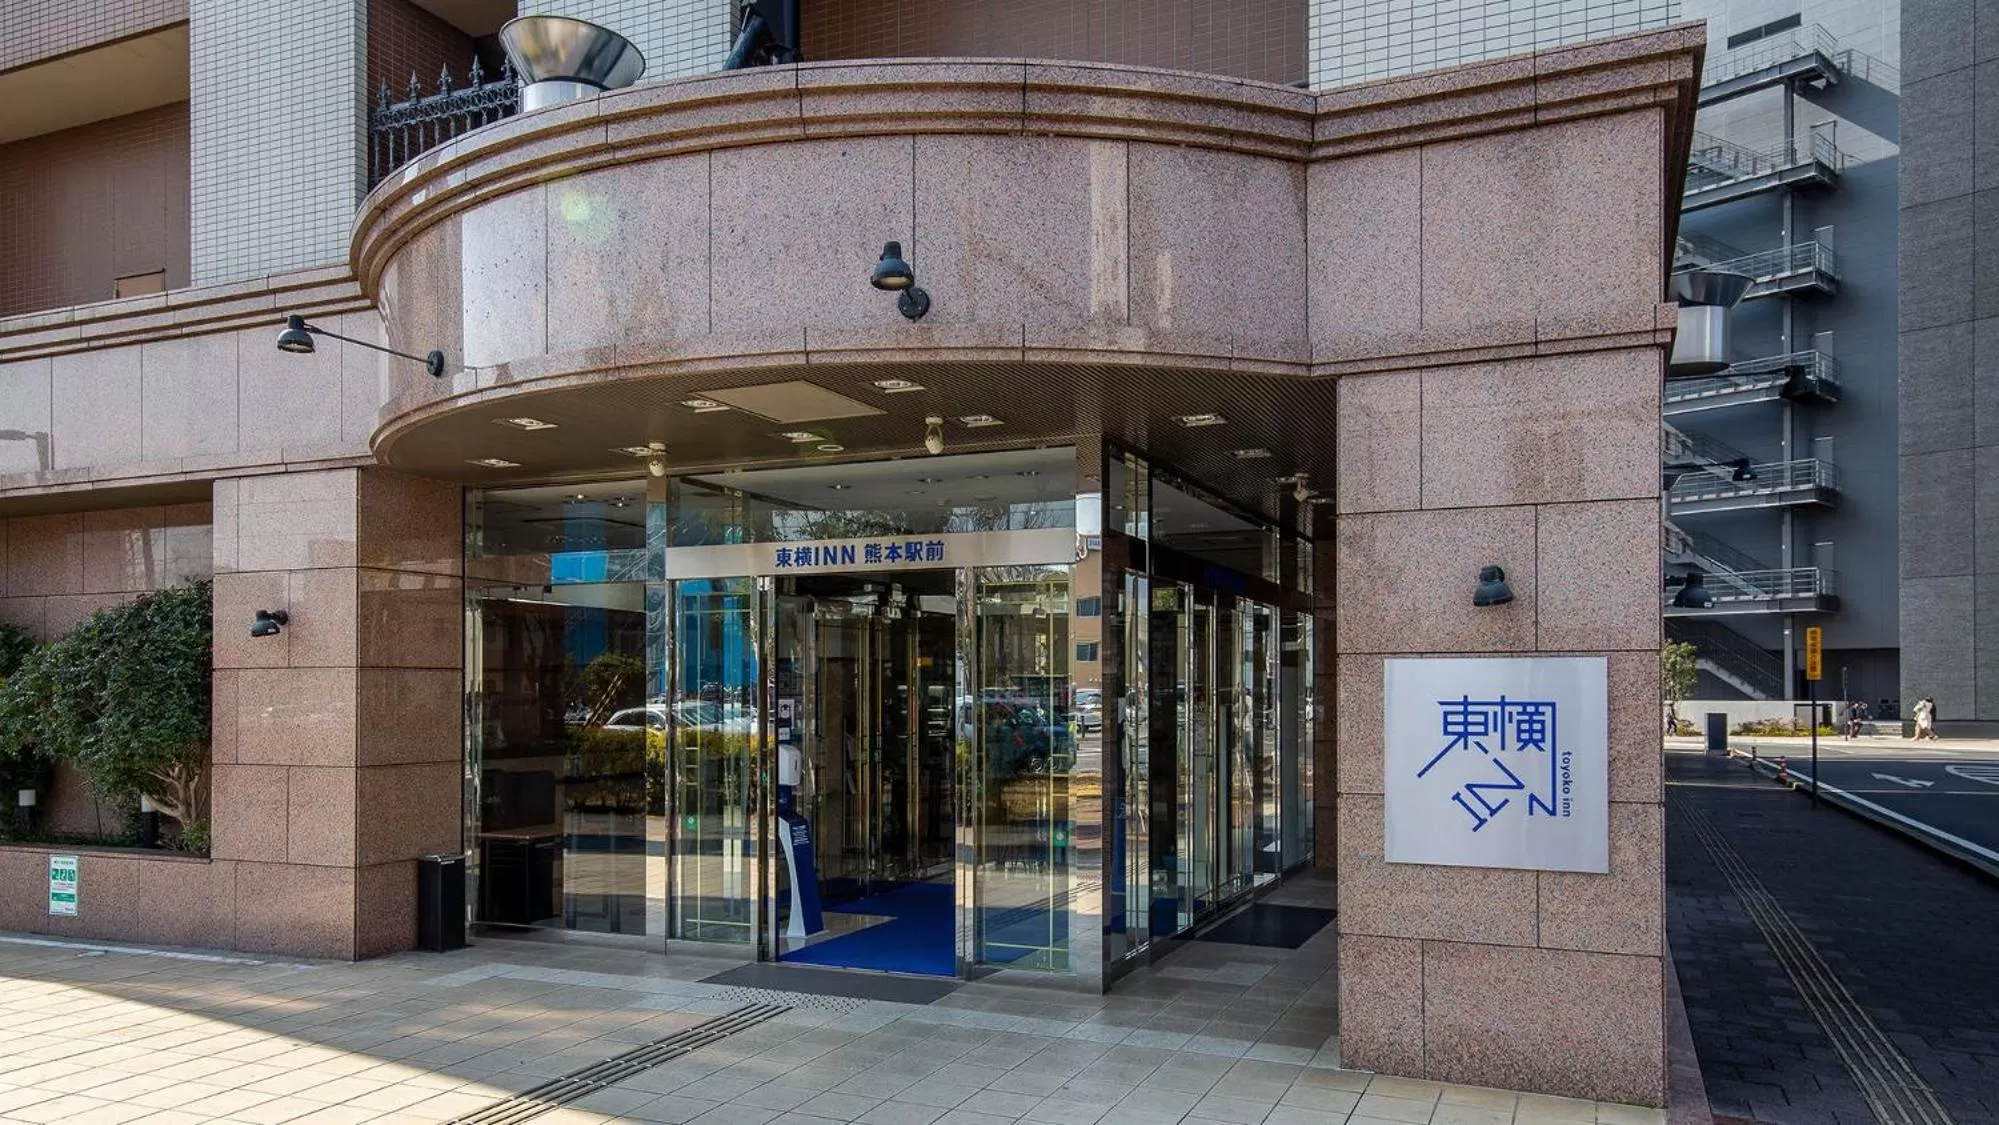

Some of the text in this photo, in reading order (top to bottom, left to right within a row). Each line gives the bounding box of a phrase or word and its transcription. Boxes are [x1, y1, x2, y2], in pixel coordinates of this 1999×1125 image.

[775, 540, 944, 568] 東横INN 熊本駅前
[1561, 751, 1573, 818] toyoko inn
